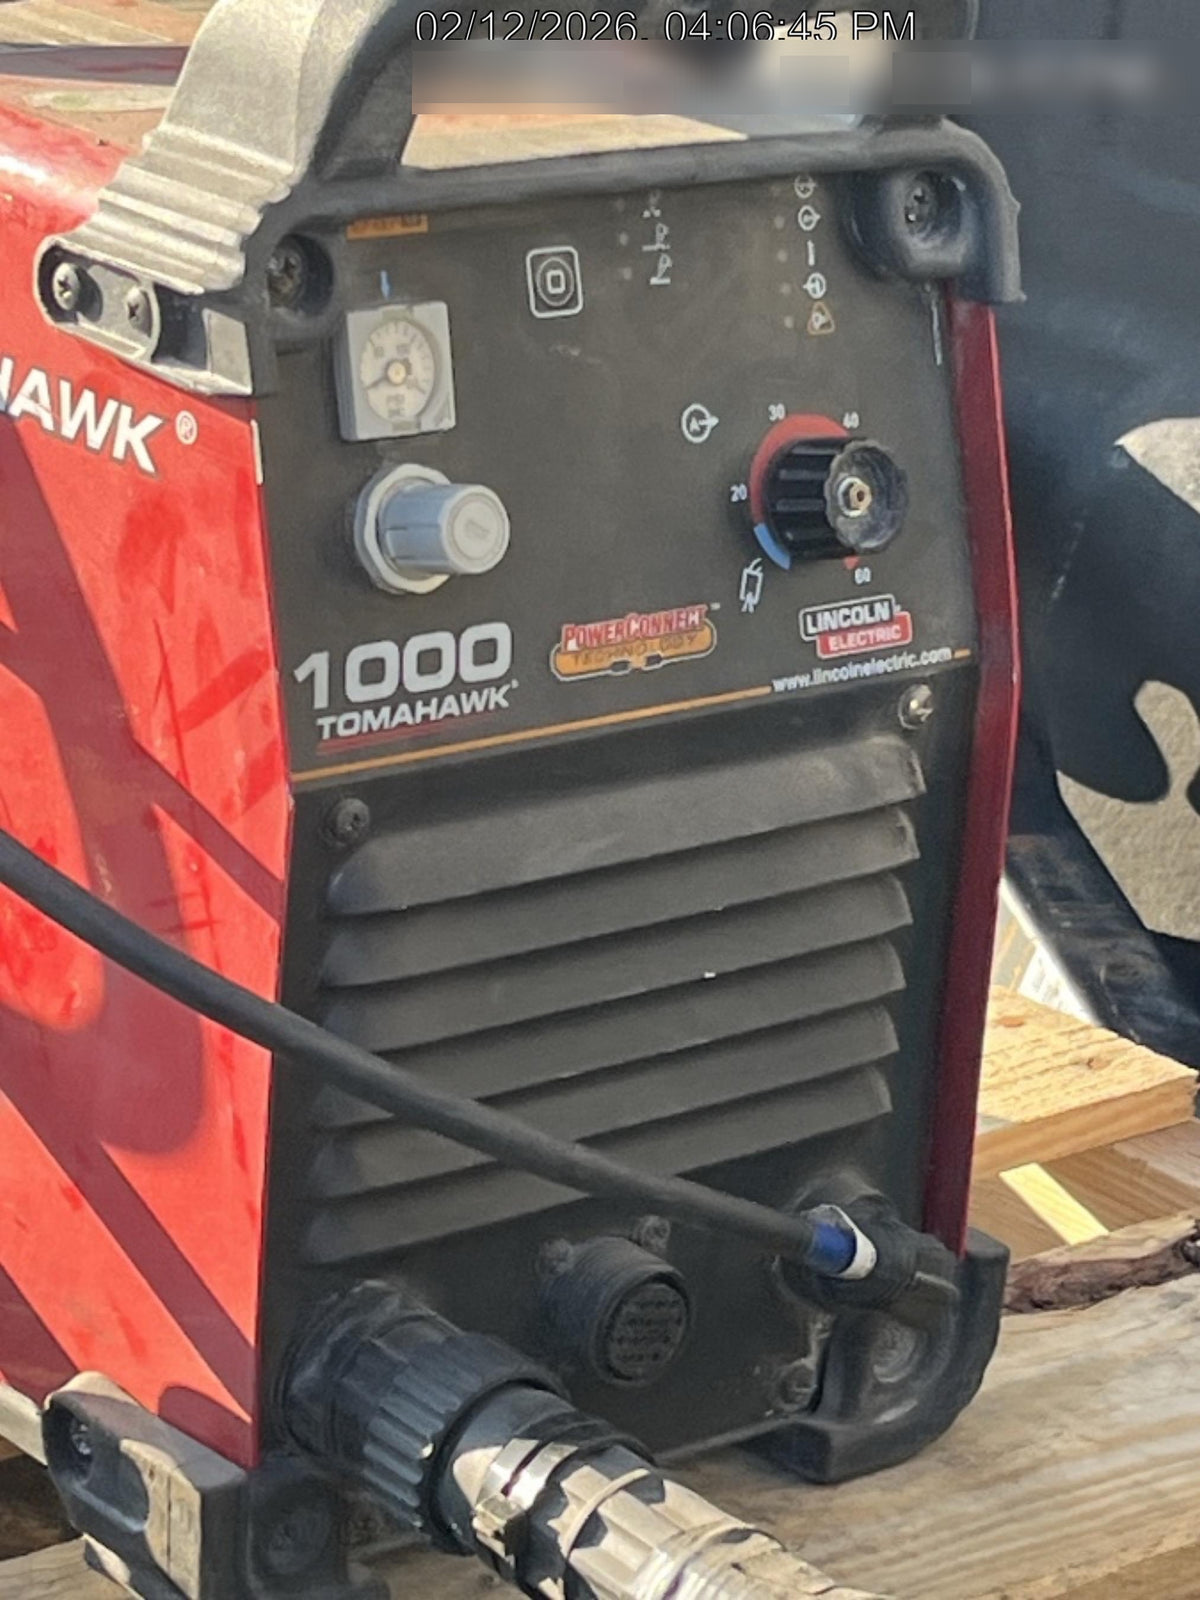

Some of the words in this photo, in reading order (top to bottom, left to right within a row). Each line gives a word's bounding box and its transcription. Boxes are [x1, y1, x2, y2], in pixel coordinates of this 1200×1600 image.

[768, 403, 785, 422] 30
[730, 483, 747, 502] 20
[806, 601, 890, 634] LINCOLN
[828, 624, 901, 651] ELECTRIC
[294, 622, 512, 710] 1000
[772, 647, 952, 693] www.lincolnelectric.com
[316, 684, 511, 740] TOMAHAWK
